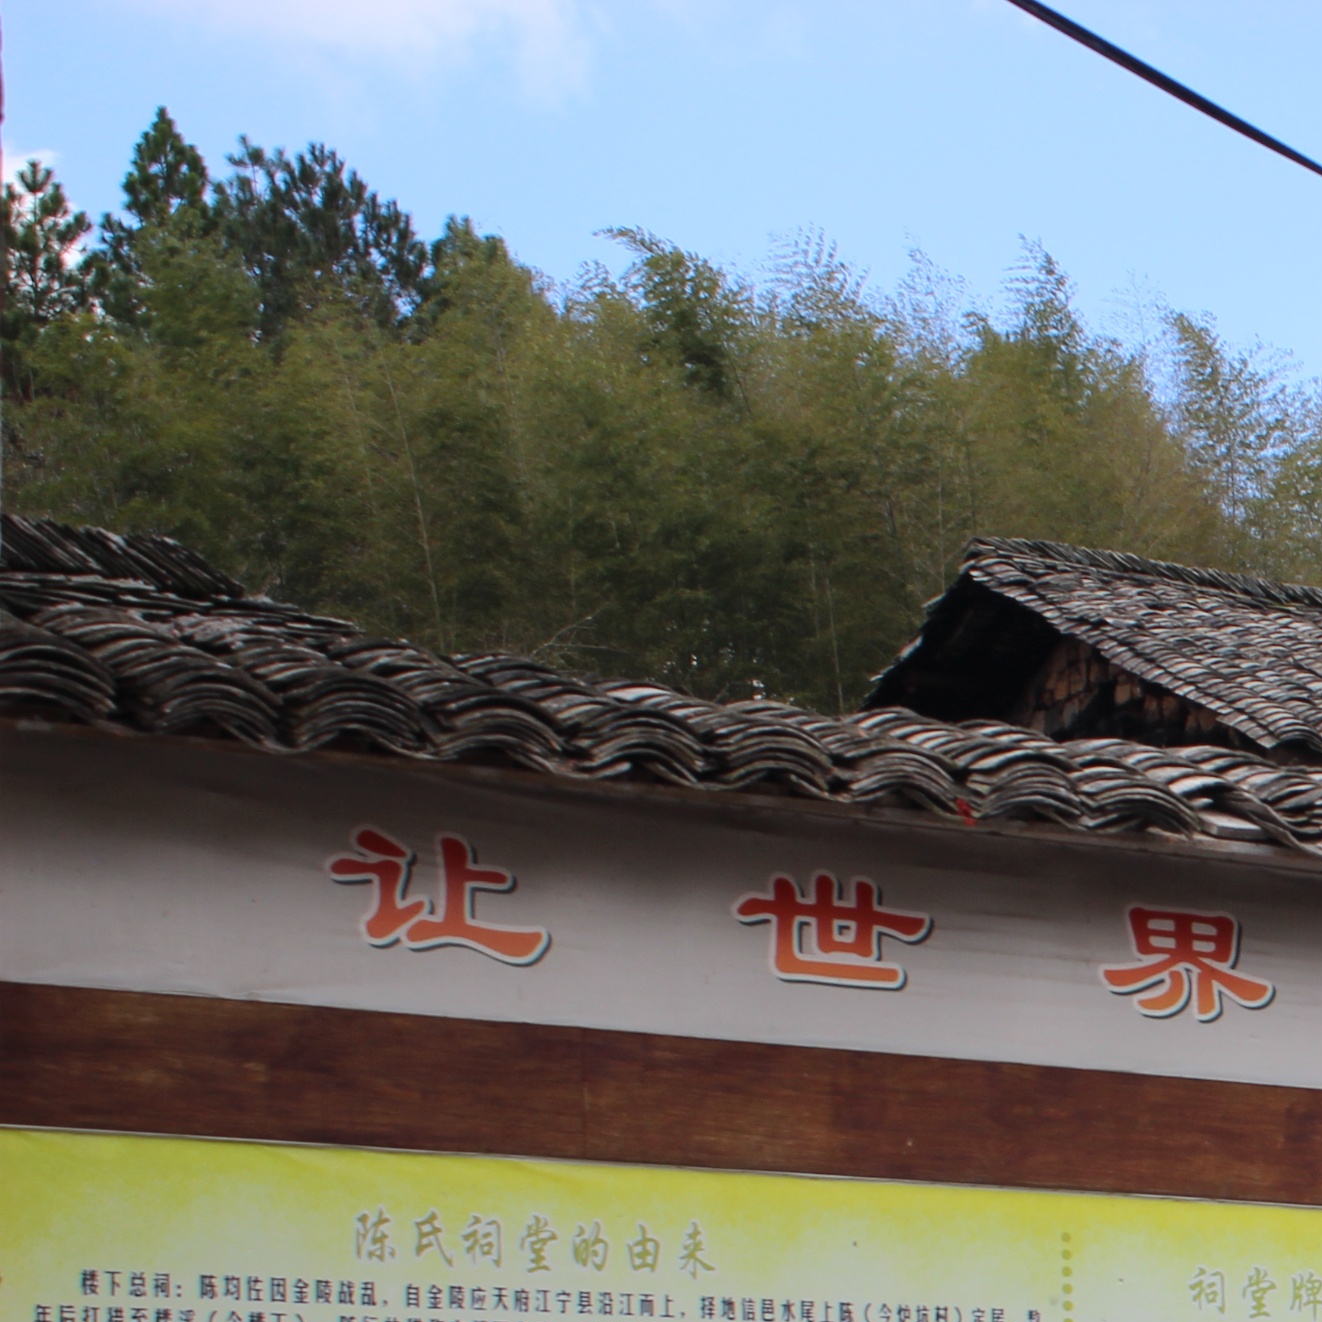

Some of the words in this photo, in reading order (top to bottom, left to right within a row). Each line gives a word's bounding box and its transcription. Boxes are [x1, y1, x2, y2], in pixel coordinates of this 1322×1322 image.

[353, 1205, 718, 1280] 陈氏祠堂的由来
